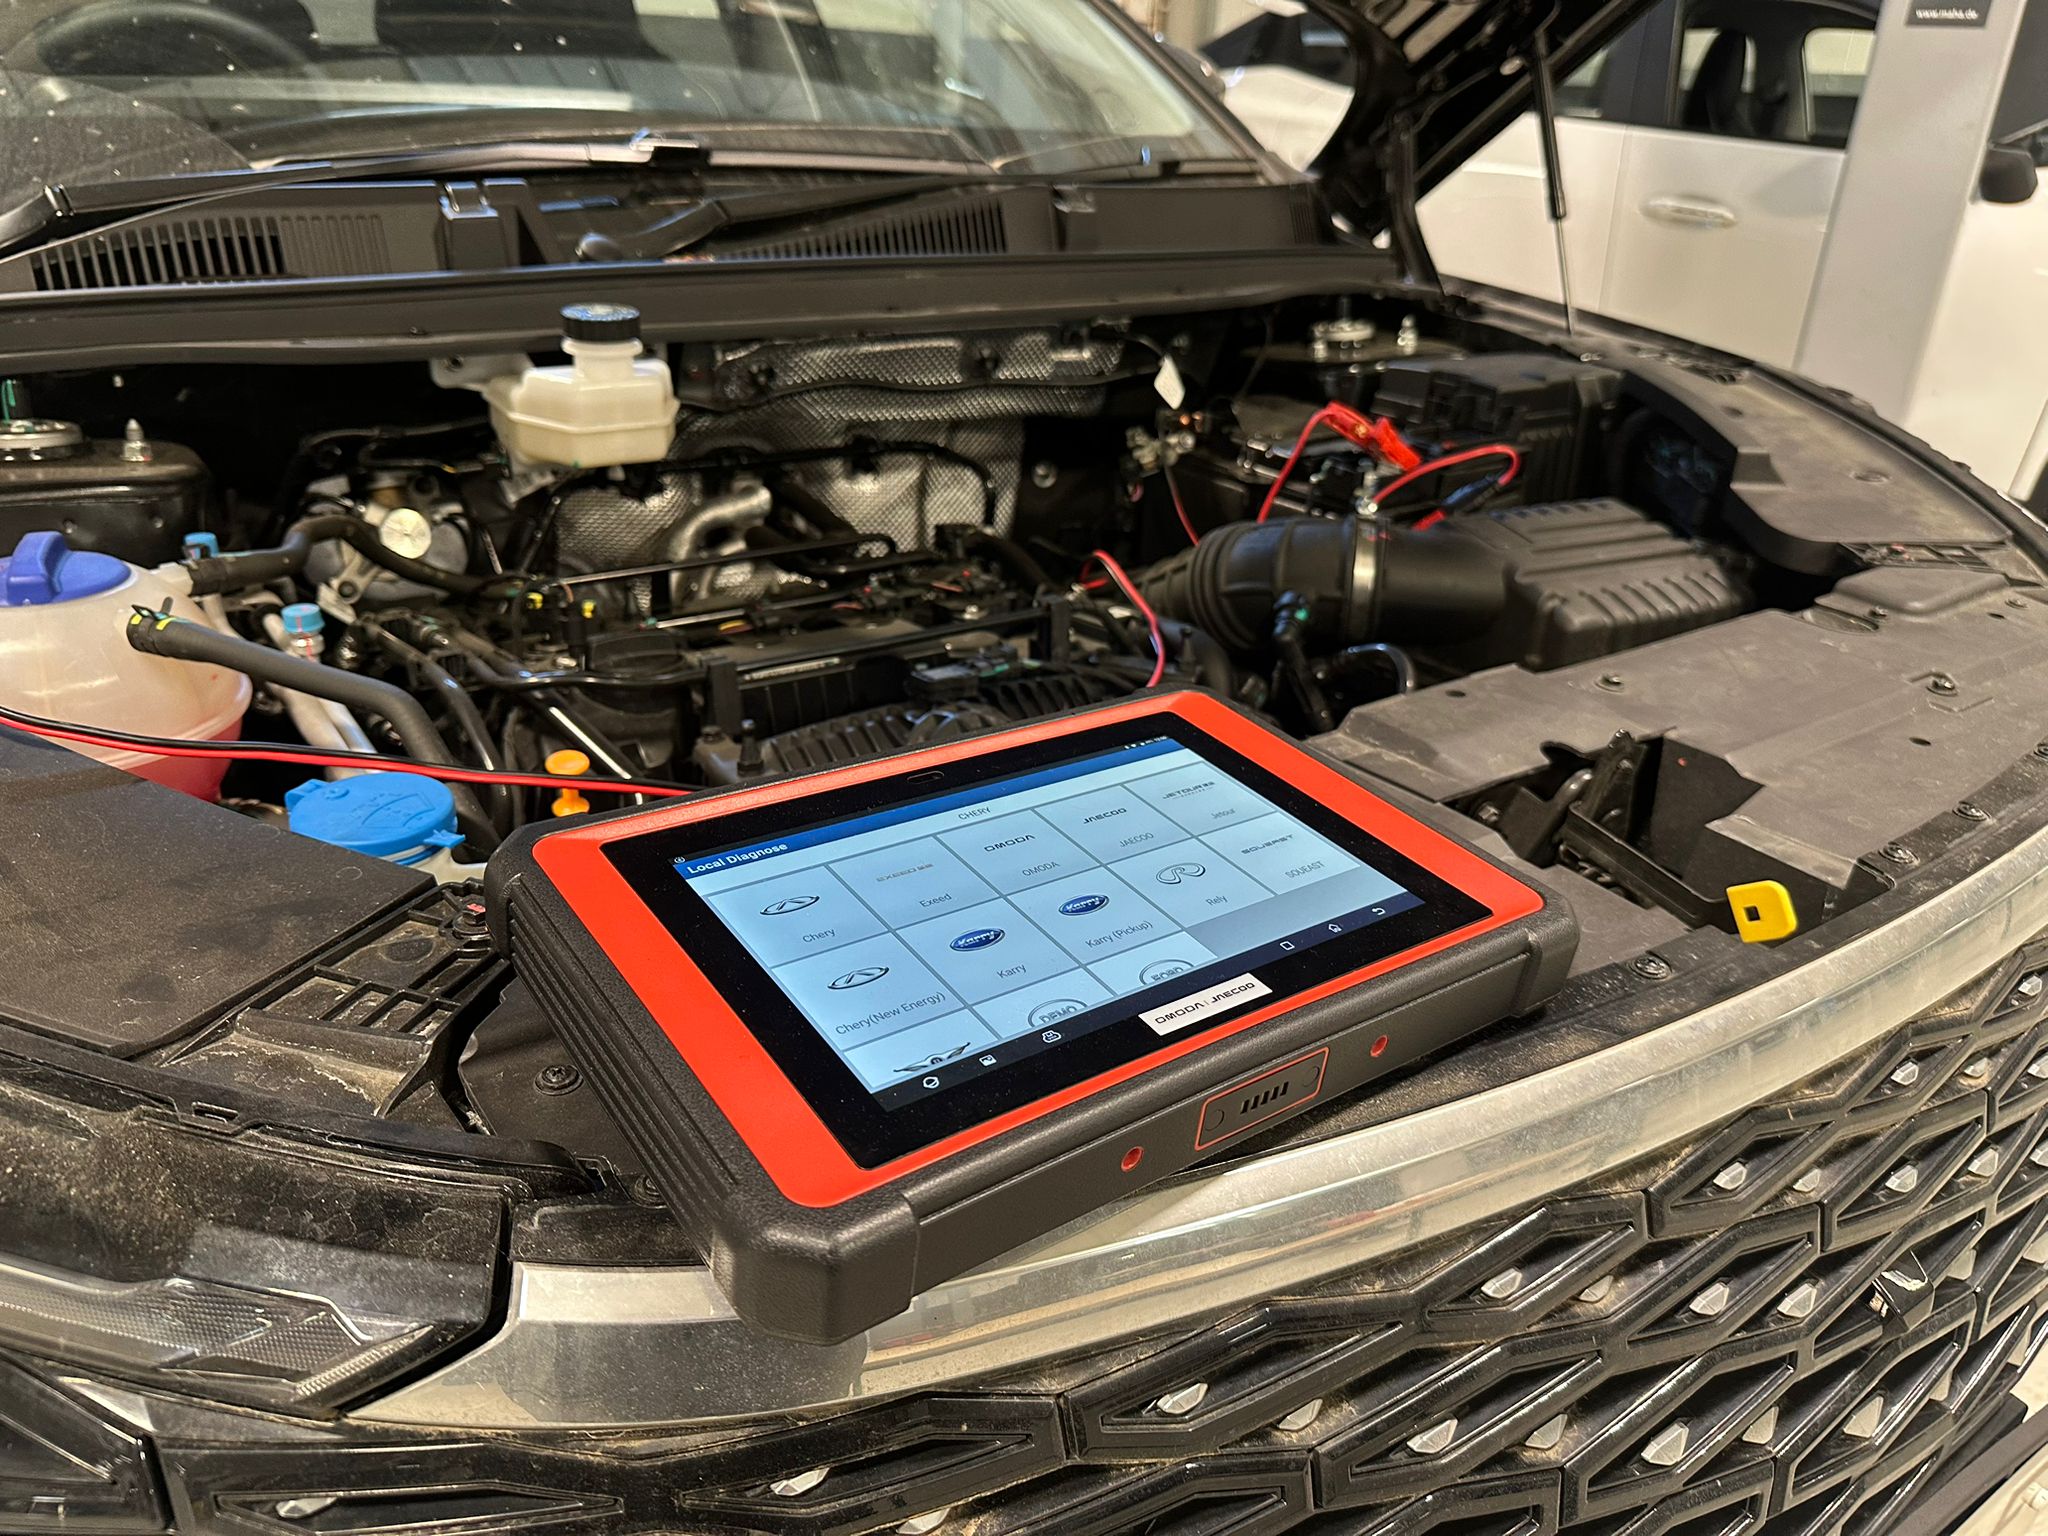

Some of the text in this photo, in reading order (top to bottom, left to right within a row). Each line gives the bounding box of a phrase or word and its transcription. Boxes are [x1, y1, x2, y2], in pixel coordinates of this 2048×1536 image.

[958, 807, 991, 820] CHERY
[1083, 807, 1127, 824] JAECOO
[984, 834, 1036, 852] OMODA
[1119, 832, 1154, 848] JAECOO
[687, 843, 788, 874] Local Diagnose
[1022, 861, 1060, 876] OMODA
[1285, 860, 1326, 878] SOUEAST
[919, 893, 952, 907] Exeed
[1066, 896, 1100, 912] Karry
[1205, 895, 1228, 906] Rely
[803, 928, 835, 943] Chery
[957, 930, 995, 947] Karry
[1085, 920, 1153, 948] Karry (Pickup)
[997, 964, 1027, 979] Karry
[1155, 982, 1255, 1024] OMODA JAECOO
[836, 992, 946, 1034] Chery(New Energy)
